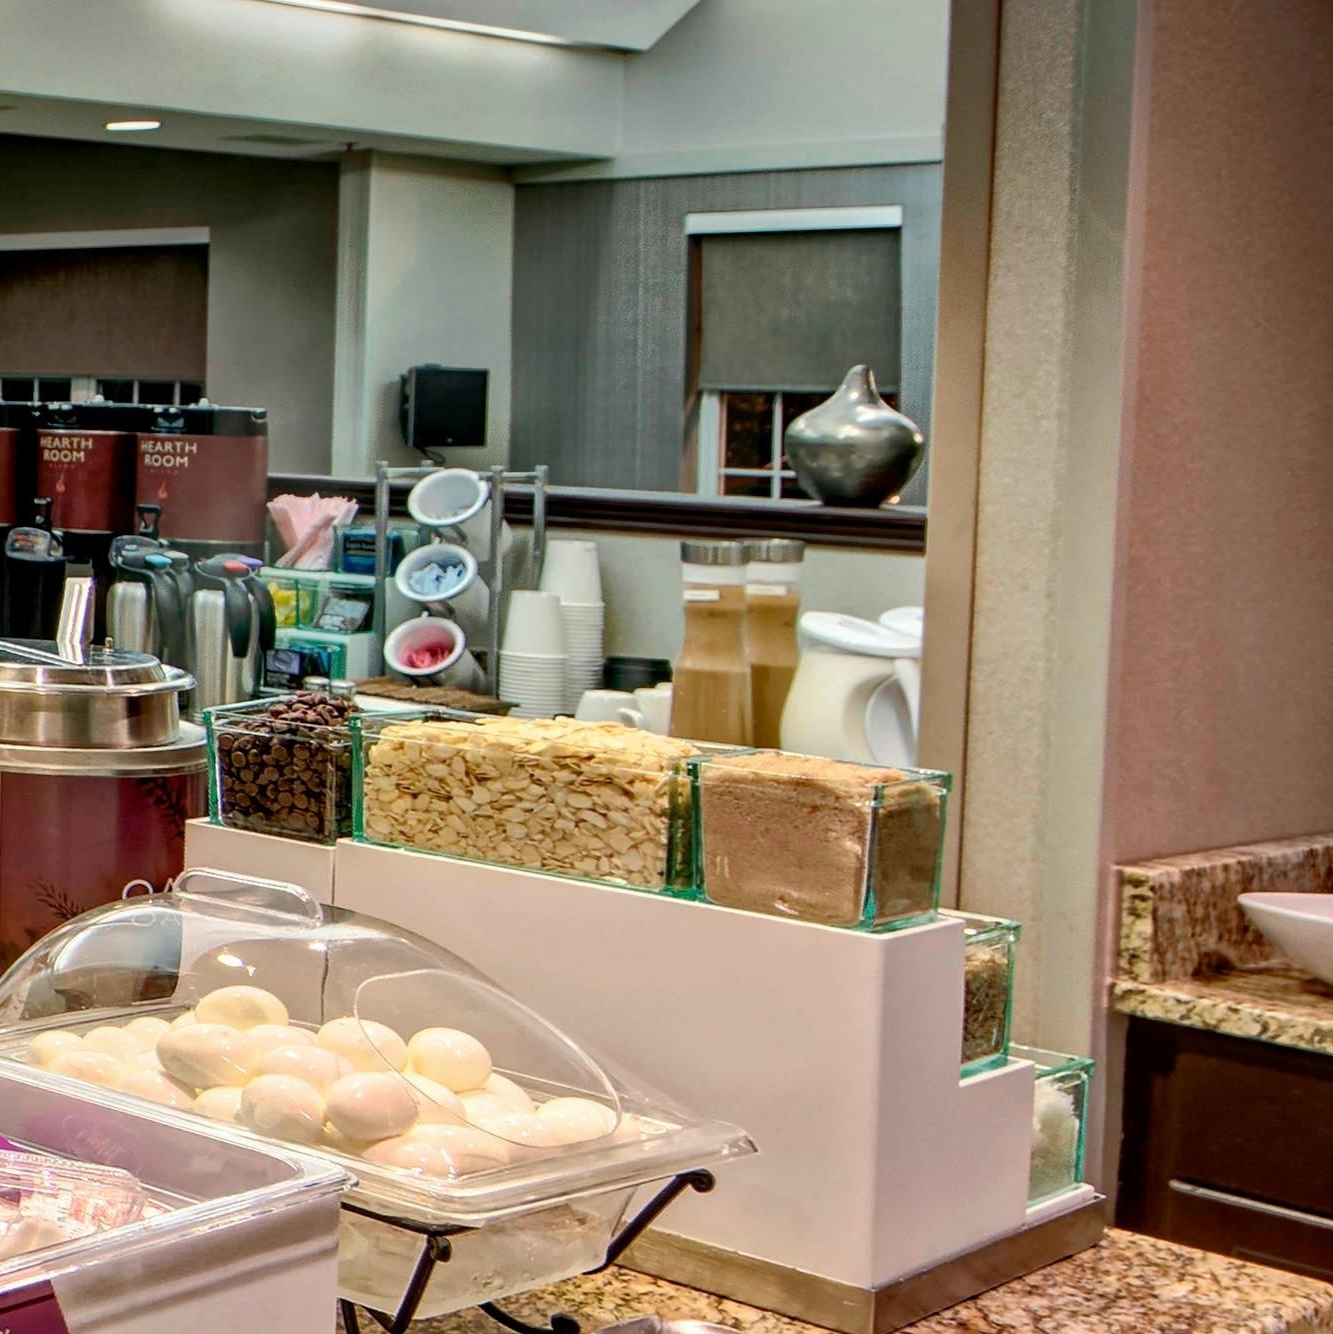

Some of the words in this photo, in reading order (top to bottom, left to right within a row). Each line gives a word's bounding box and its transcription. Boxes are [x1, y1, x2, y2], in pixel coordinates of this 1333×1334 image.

[39, 436, 93, 449] HEARTH
[140, 439, 198, 454] HEARTH
[43, 449, 85, 462] ROOM
[144, 453, 189, 468] ROOM
